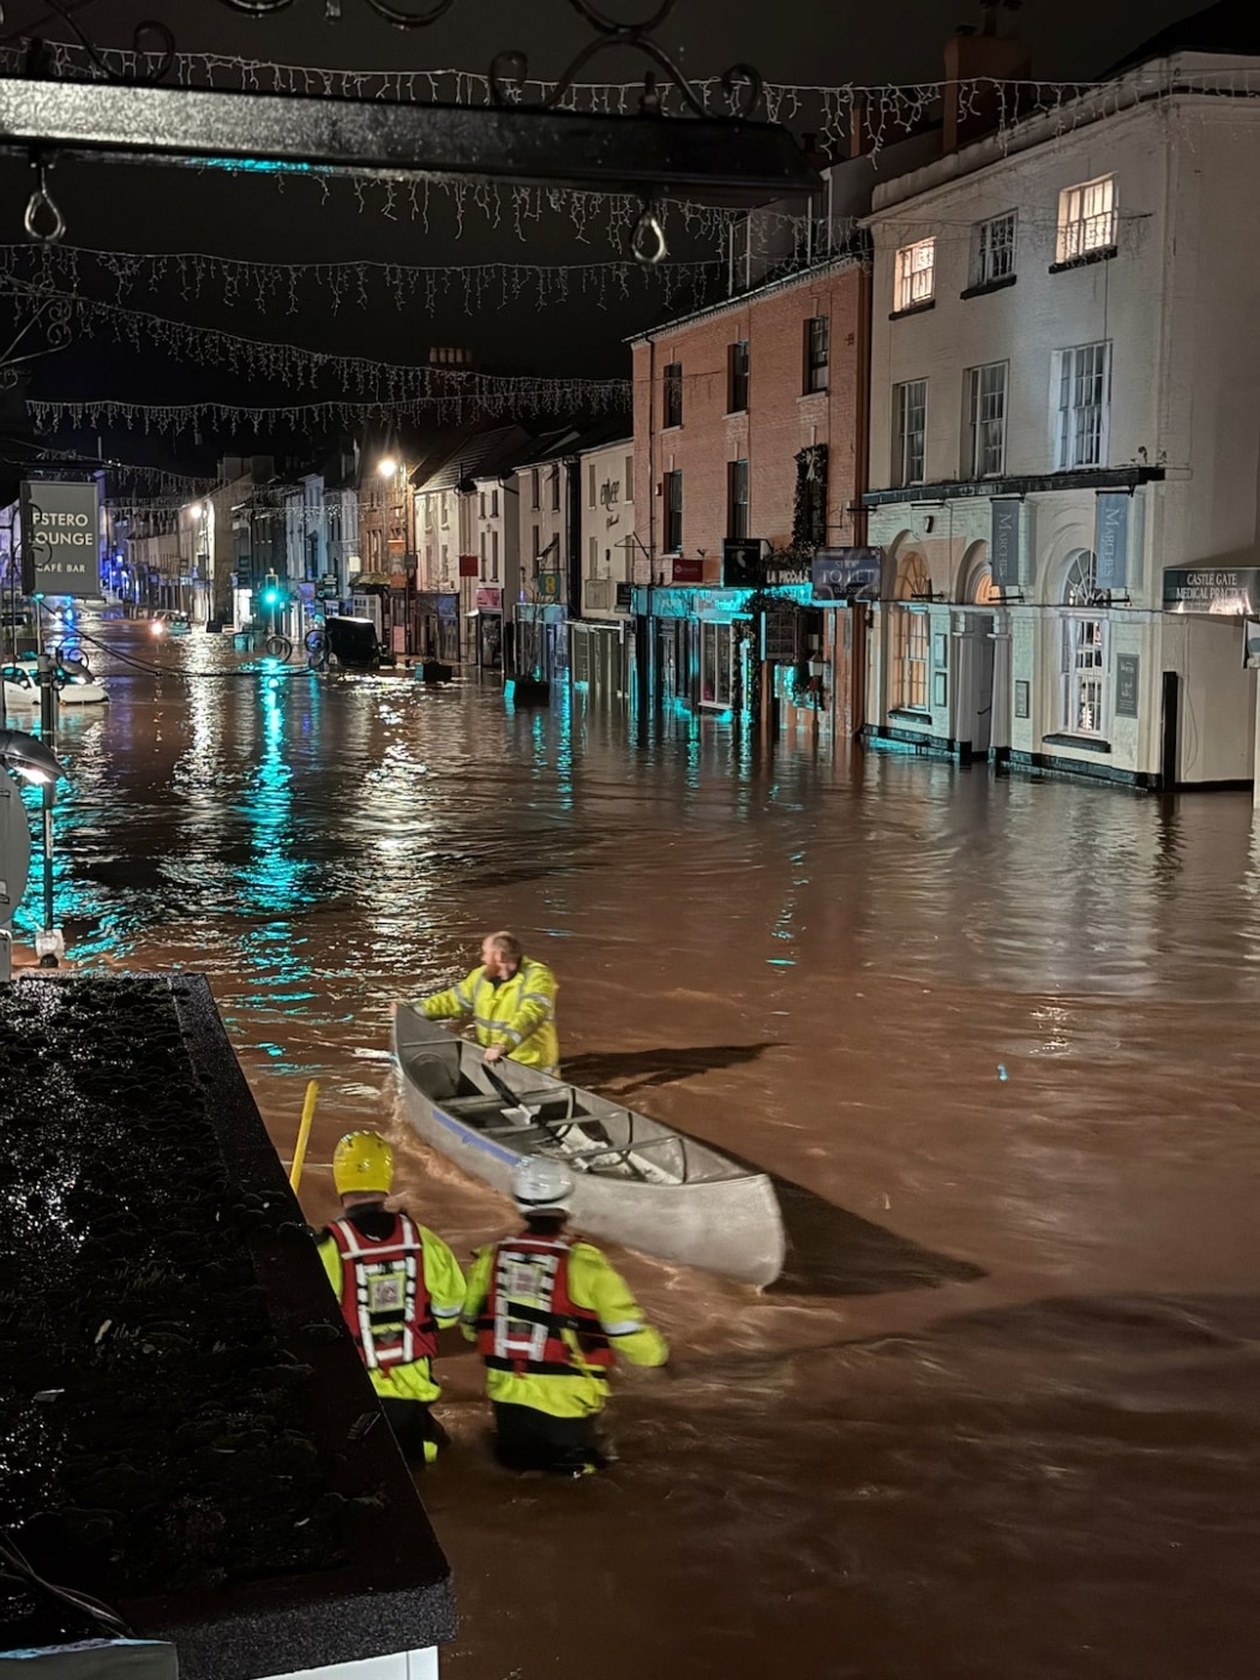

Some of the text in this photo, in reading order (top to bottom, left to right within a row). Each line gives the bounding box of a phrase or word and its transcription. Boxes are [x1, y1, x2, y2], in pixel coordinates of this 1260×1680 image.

[66, 563, 86, 573] BAR
[822, 569, 843, 583] TO
[1186, 572, 1238, 586] CASTLE GATE
[1175, 587, 1209, 600] MEDICAL
